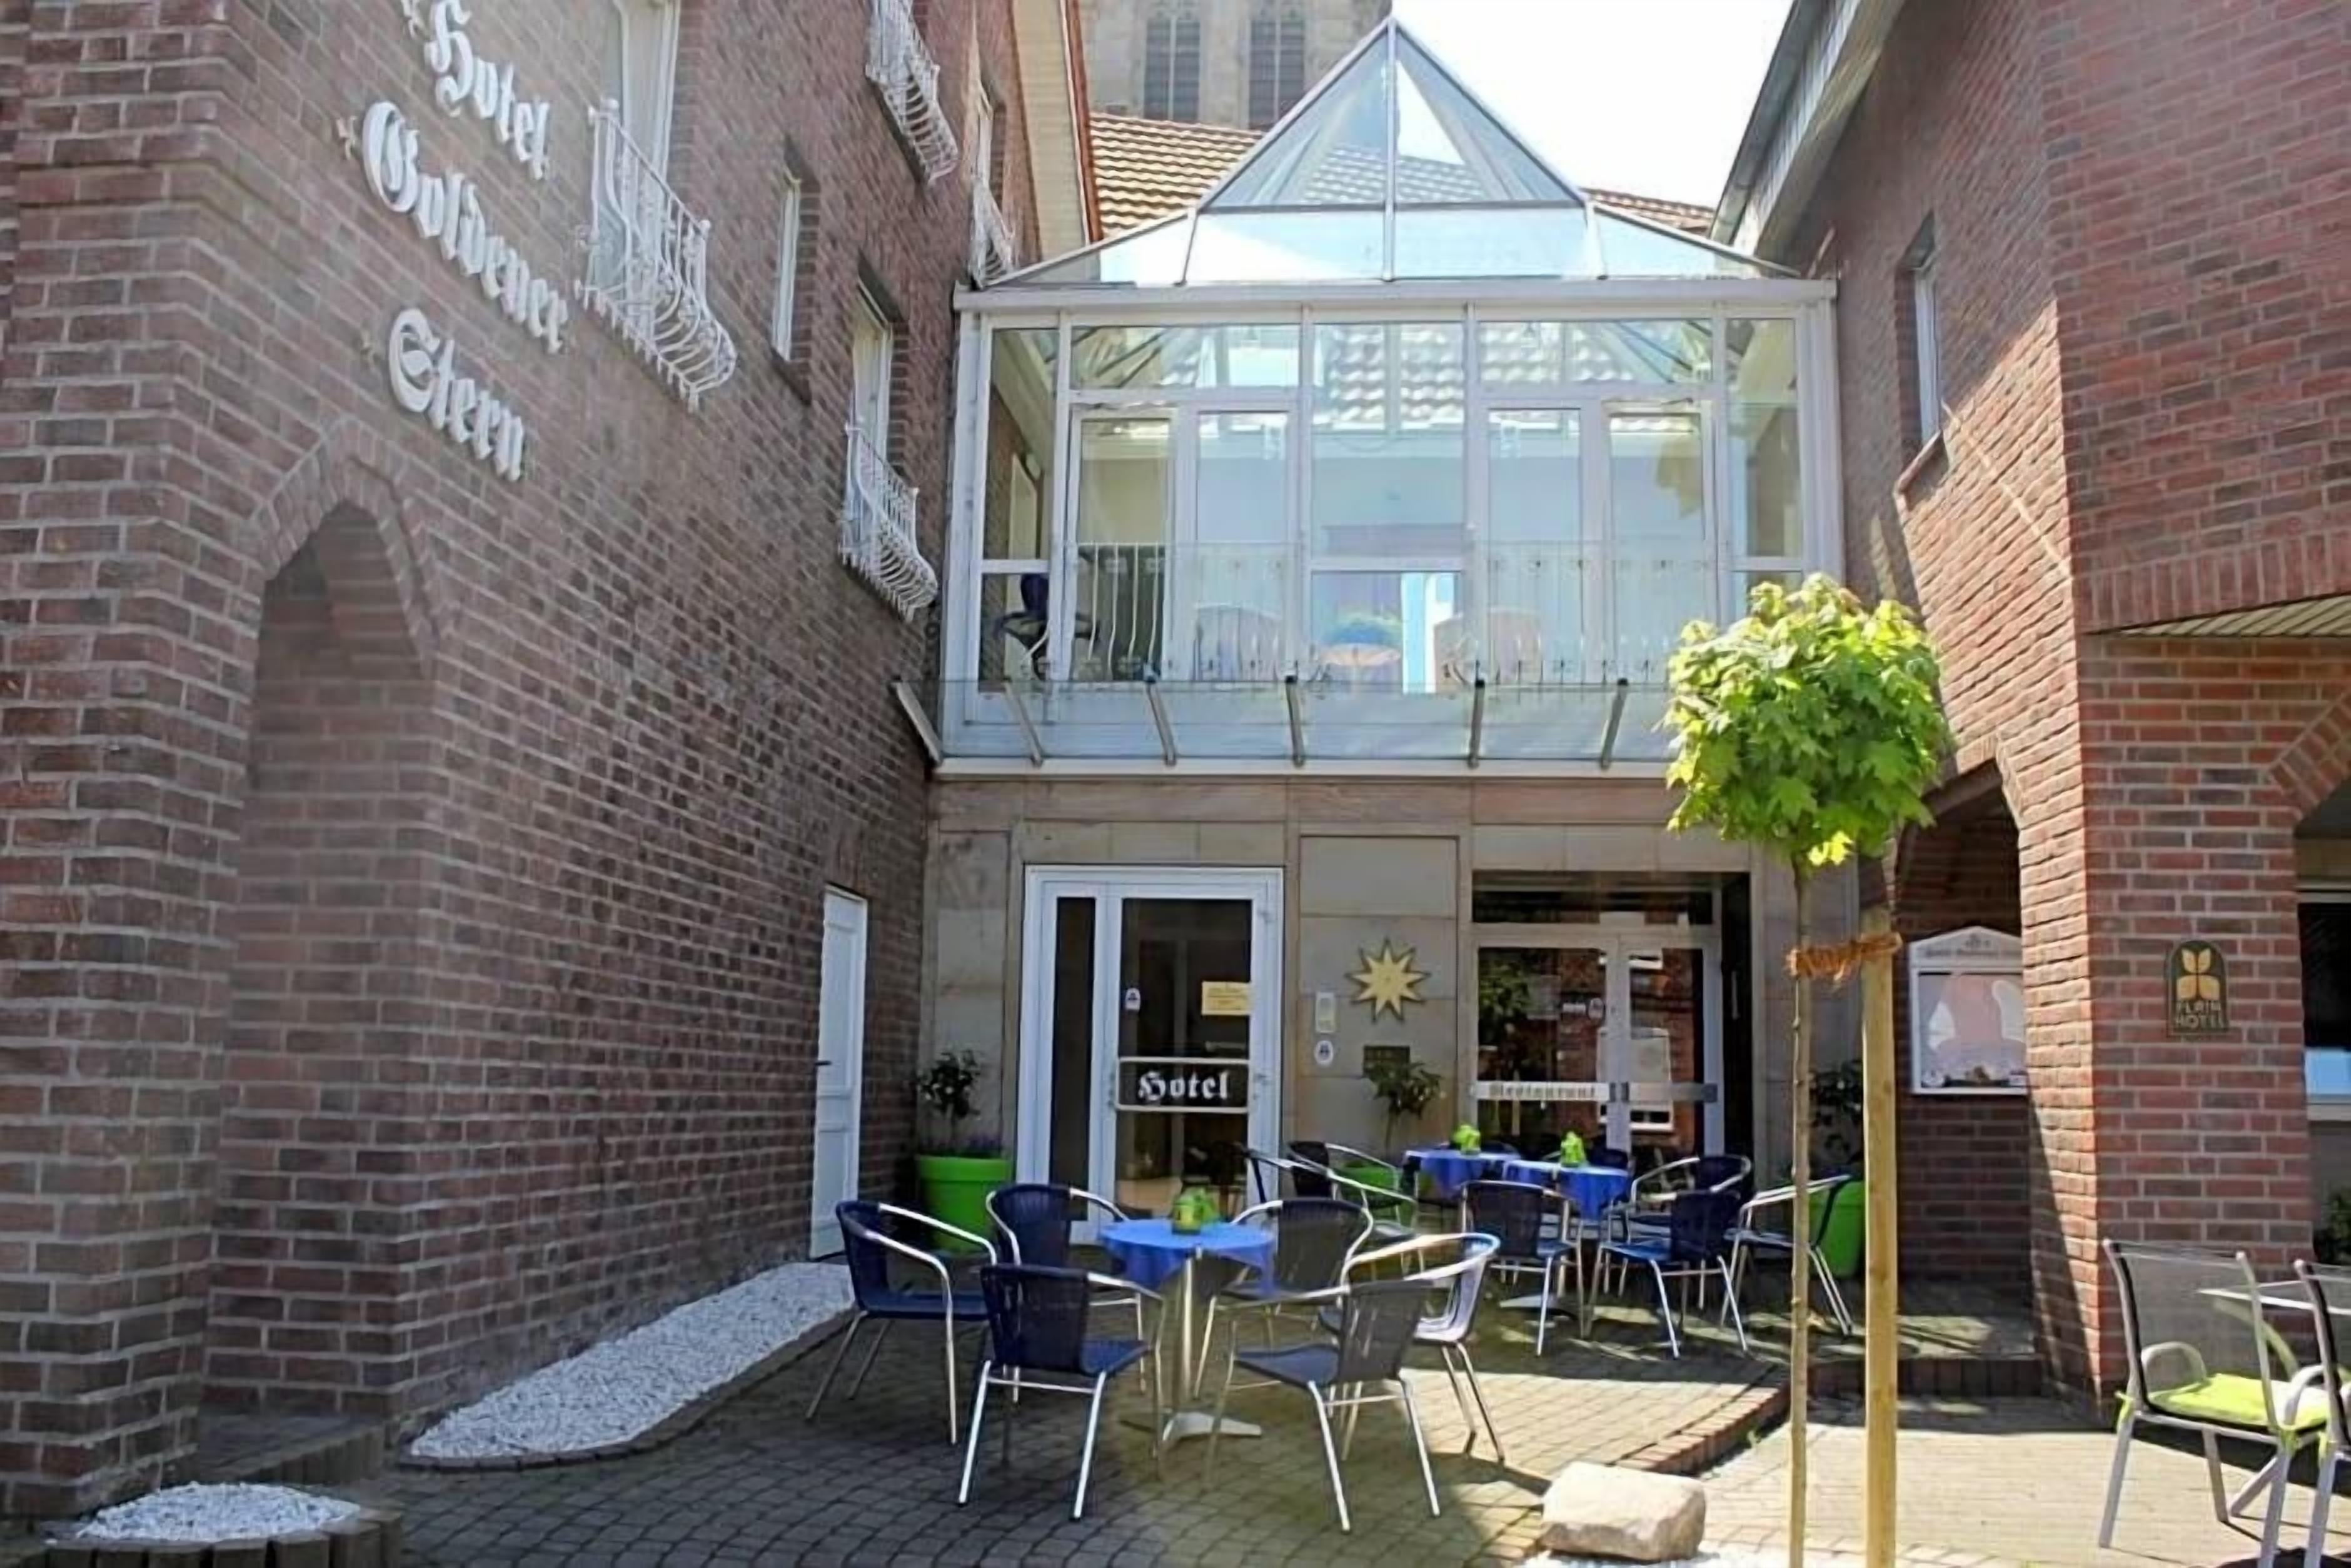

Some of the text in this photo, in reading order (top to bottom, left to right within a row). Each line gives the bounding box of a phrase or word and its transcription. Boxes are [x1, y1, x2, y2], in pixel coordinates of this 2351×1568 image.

[424, 0, 551, 180] Hotel
[363, 101, 568, 353] Goldener
[388, 308, 524, 482] Stern
[1138, 1070, 1229, 1101] Hotel
